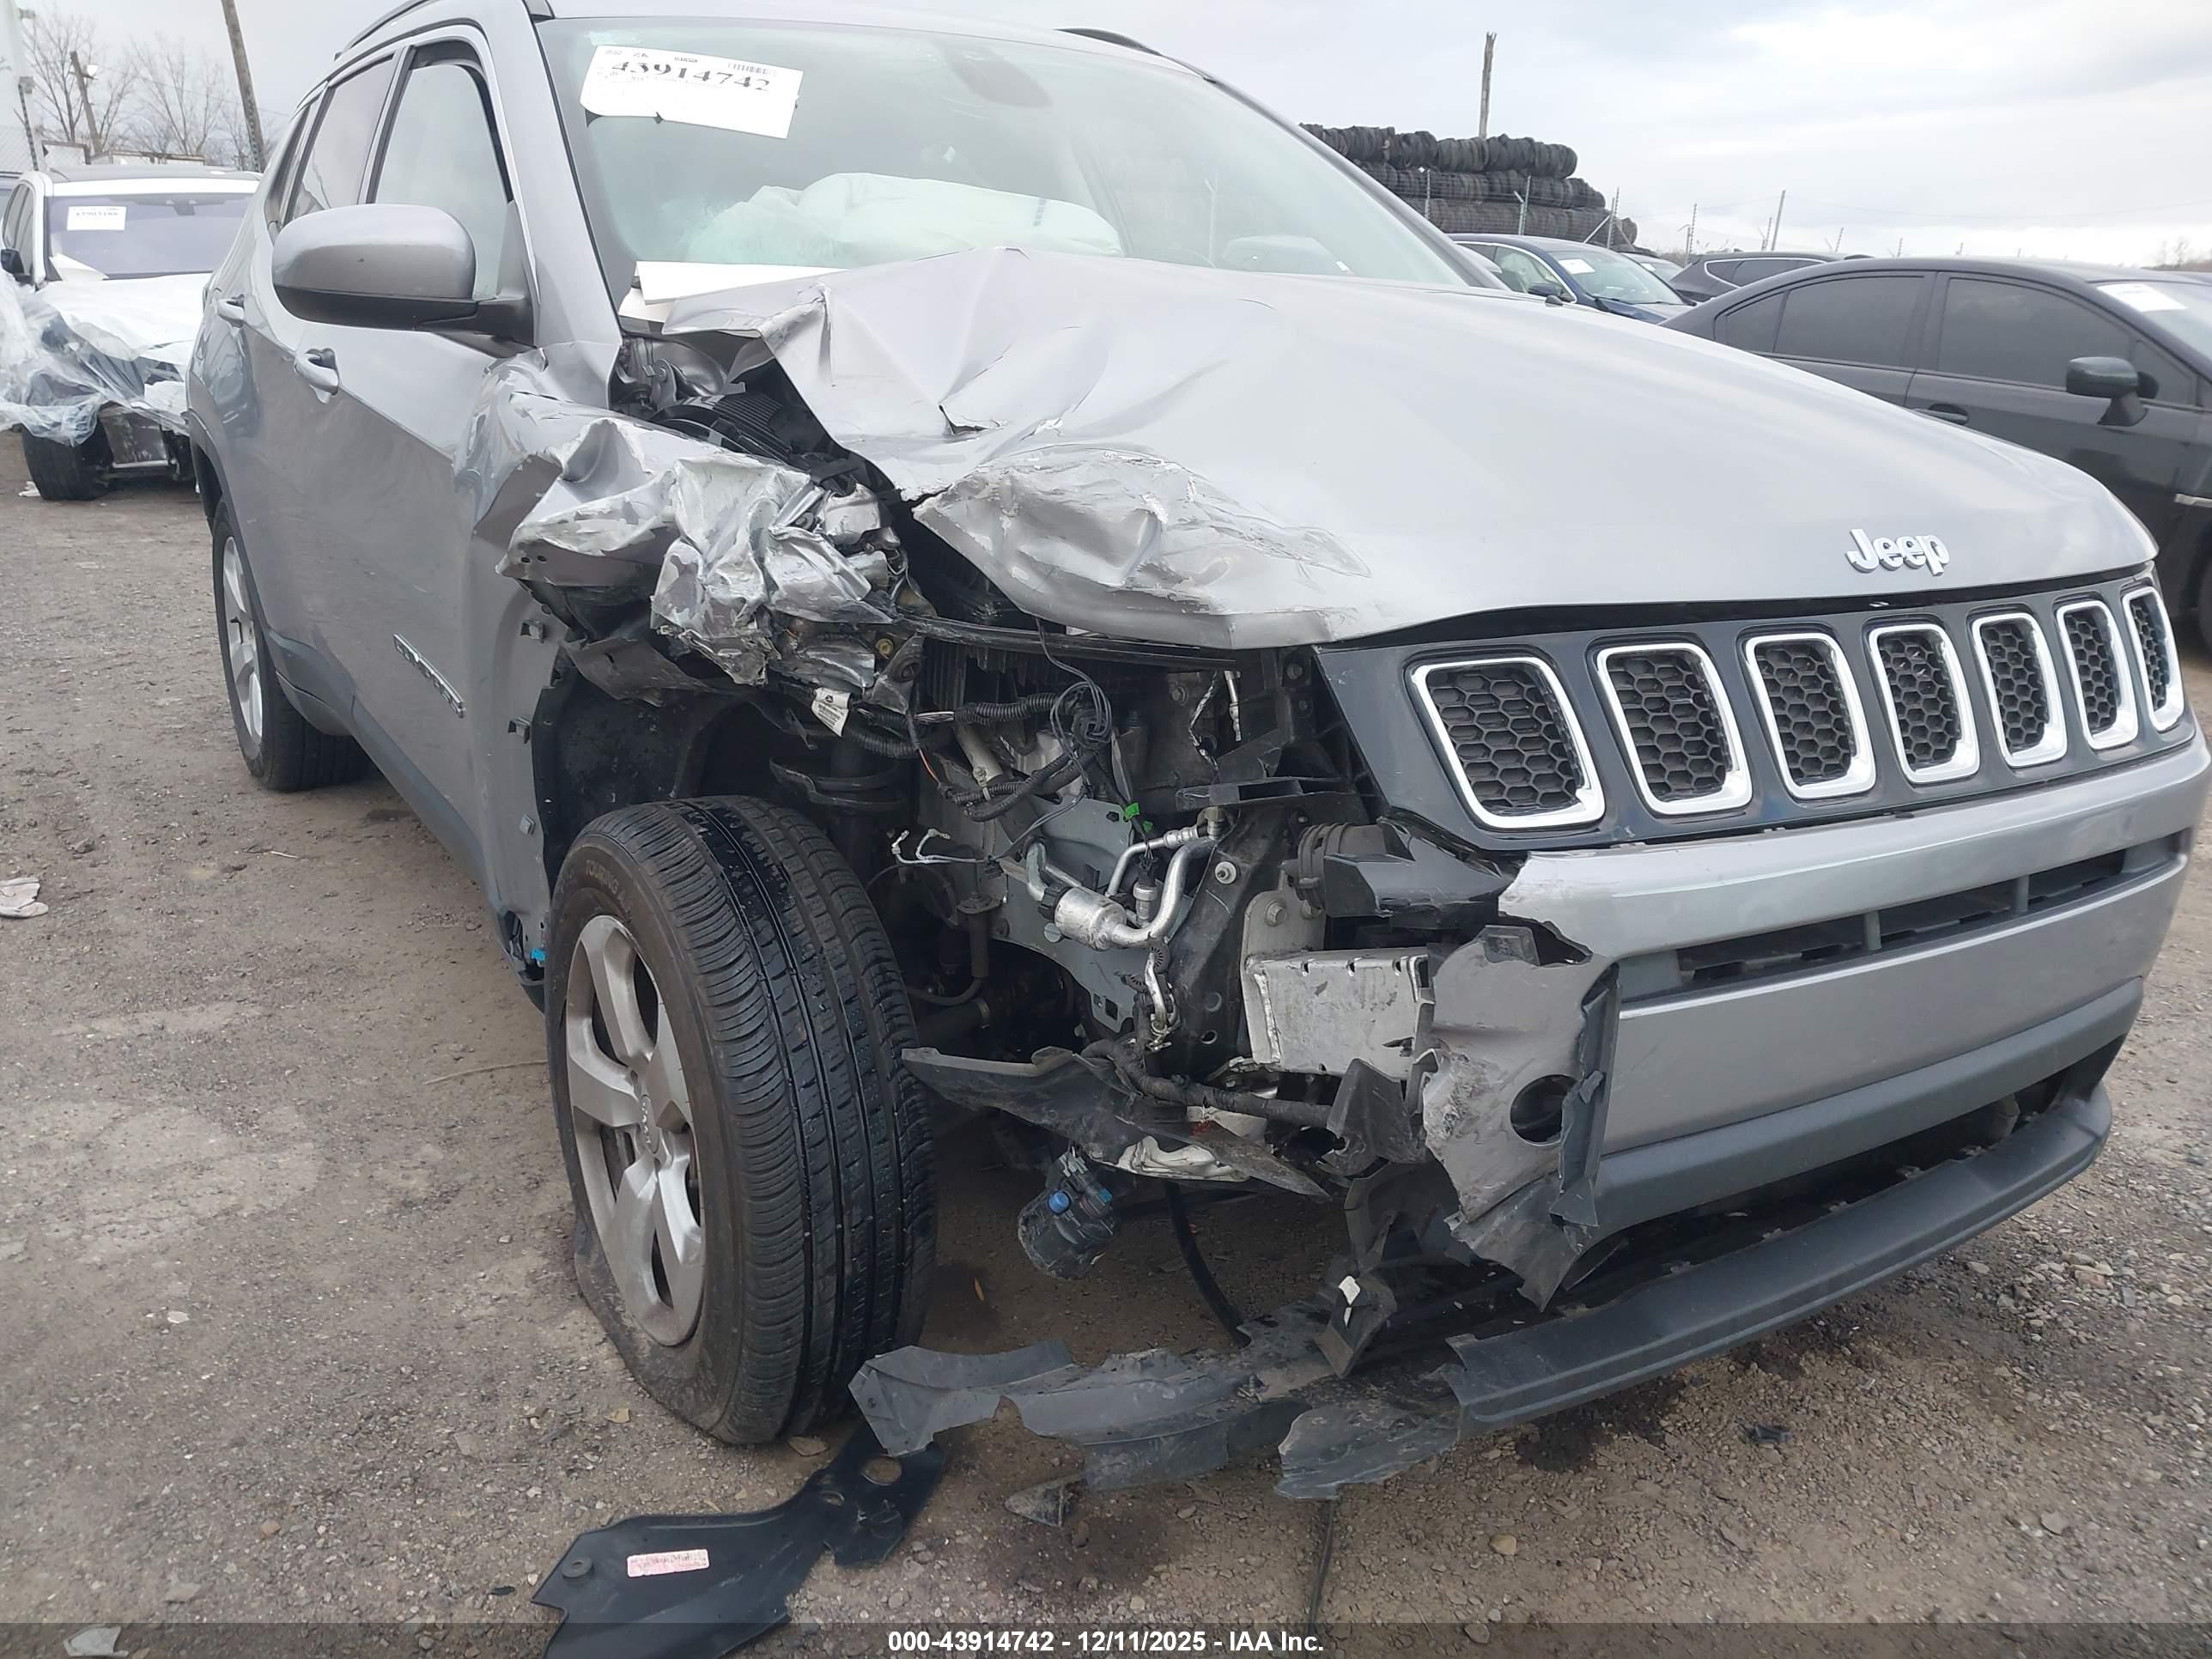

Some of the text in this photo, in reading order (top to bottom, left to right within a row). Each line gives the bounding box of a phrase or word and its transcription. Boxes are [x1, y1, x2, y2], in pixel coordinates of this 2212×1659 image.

[611, 60, 771, 92] 43914742
[1845, 528, 1950, 576] Jeep
[585, 860, 619, 896] TOURING
